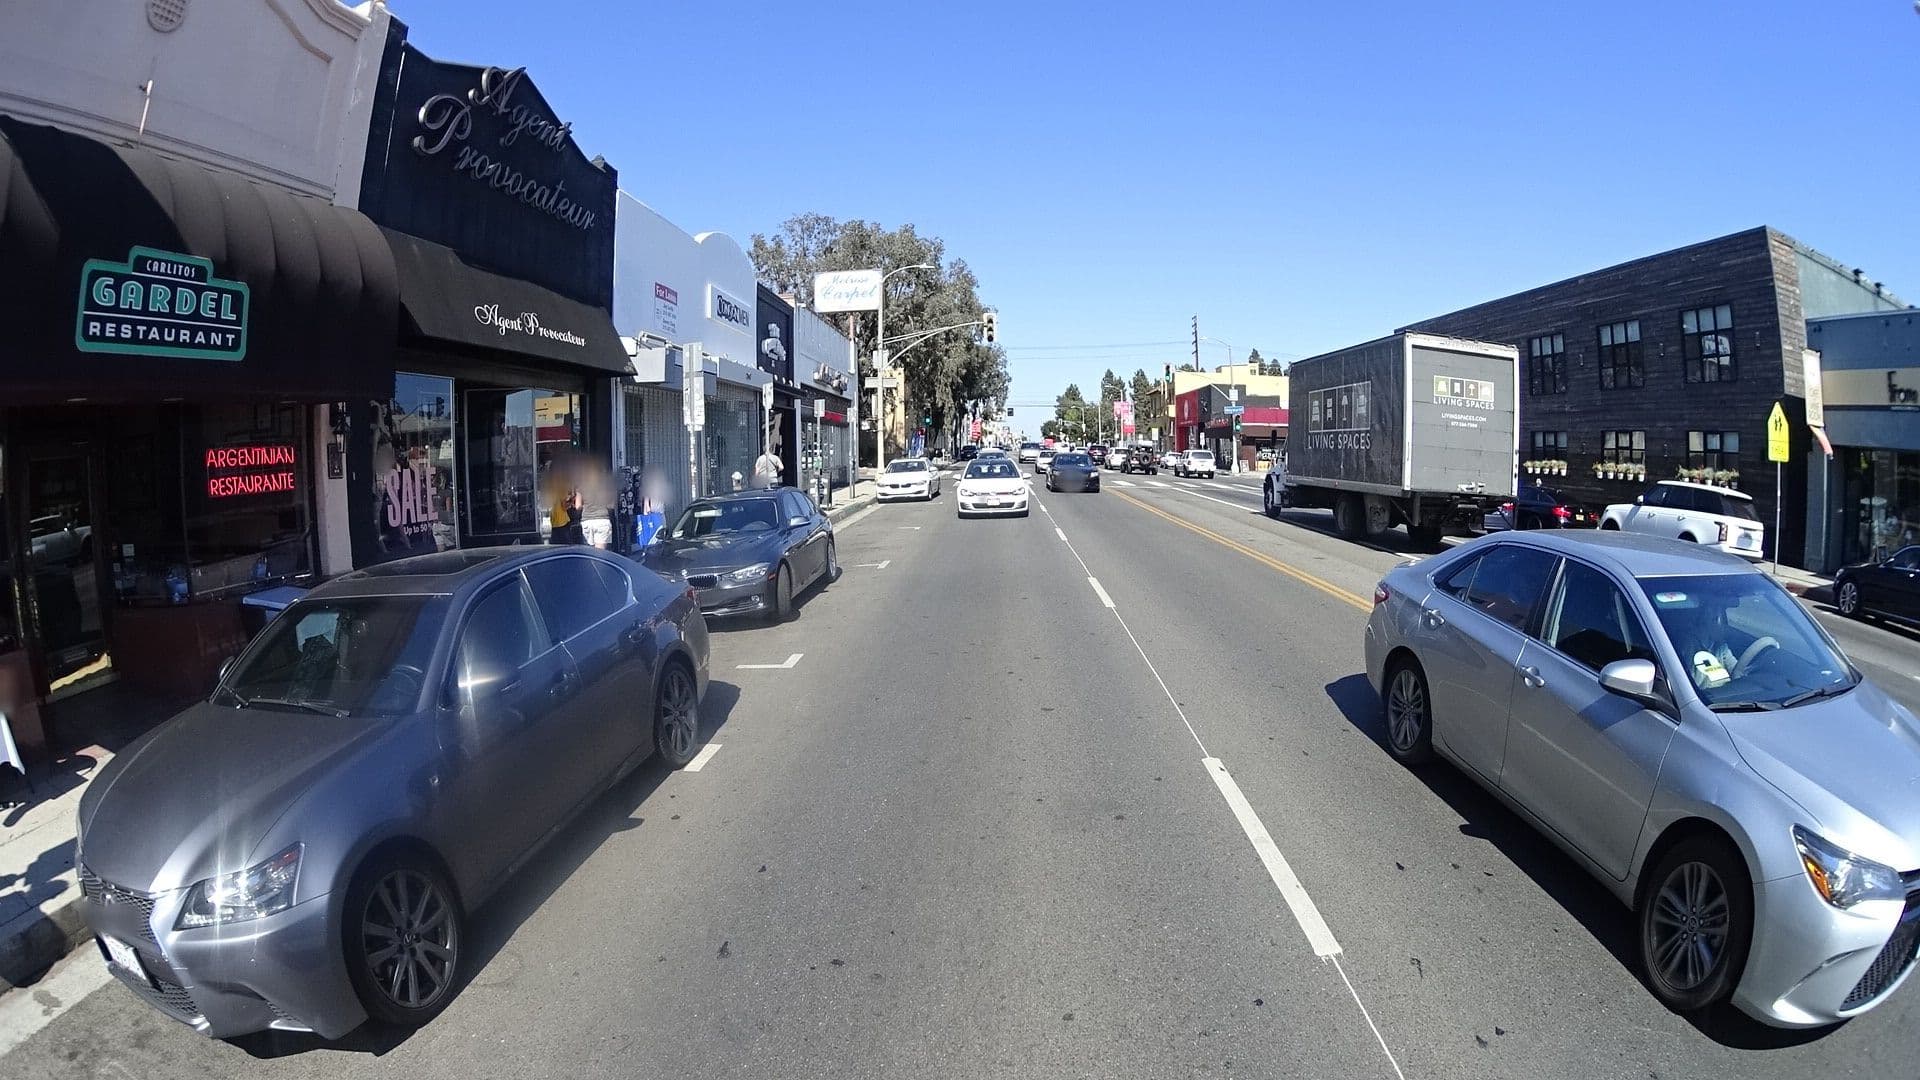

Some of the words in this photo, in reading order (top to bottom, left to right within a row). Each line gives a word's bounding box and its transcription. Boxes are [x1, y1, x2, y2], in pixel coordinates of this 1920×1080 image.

[468, 66, 573, 151] Agent
[413, 94, 596, 230] Provocateur
[146, 259, 195, 278] CARLITOS
[92, 276, 237, 321] GARDEL
[88, 321, 236, 347] RESTAURANT
[474, 304, 522, 335] Agent
[521, 312, 585, 347] Provocateur
[1433, 396, 1463, 407] LIVING
[1465, 400, 1495, 410] SPACES
[1308, 434, 1335, 449] LIVING
[1338, 432, 1371, 449] SPACES
[207, 446, 295, 468] ARGENTINIAN
[209, 472, 295, 496] RESTAURANTE
[384, 466, 439, 528] SALE
[403, 525, 413, 537] Up
[413, 524, 420, 534] to
